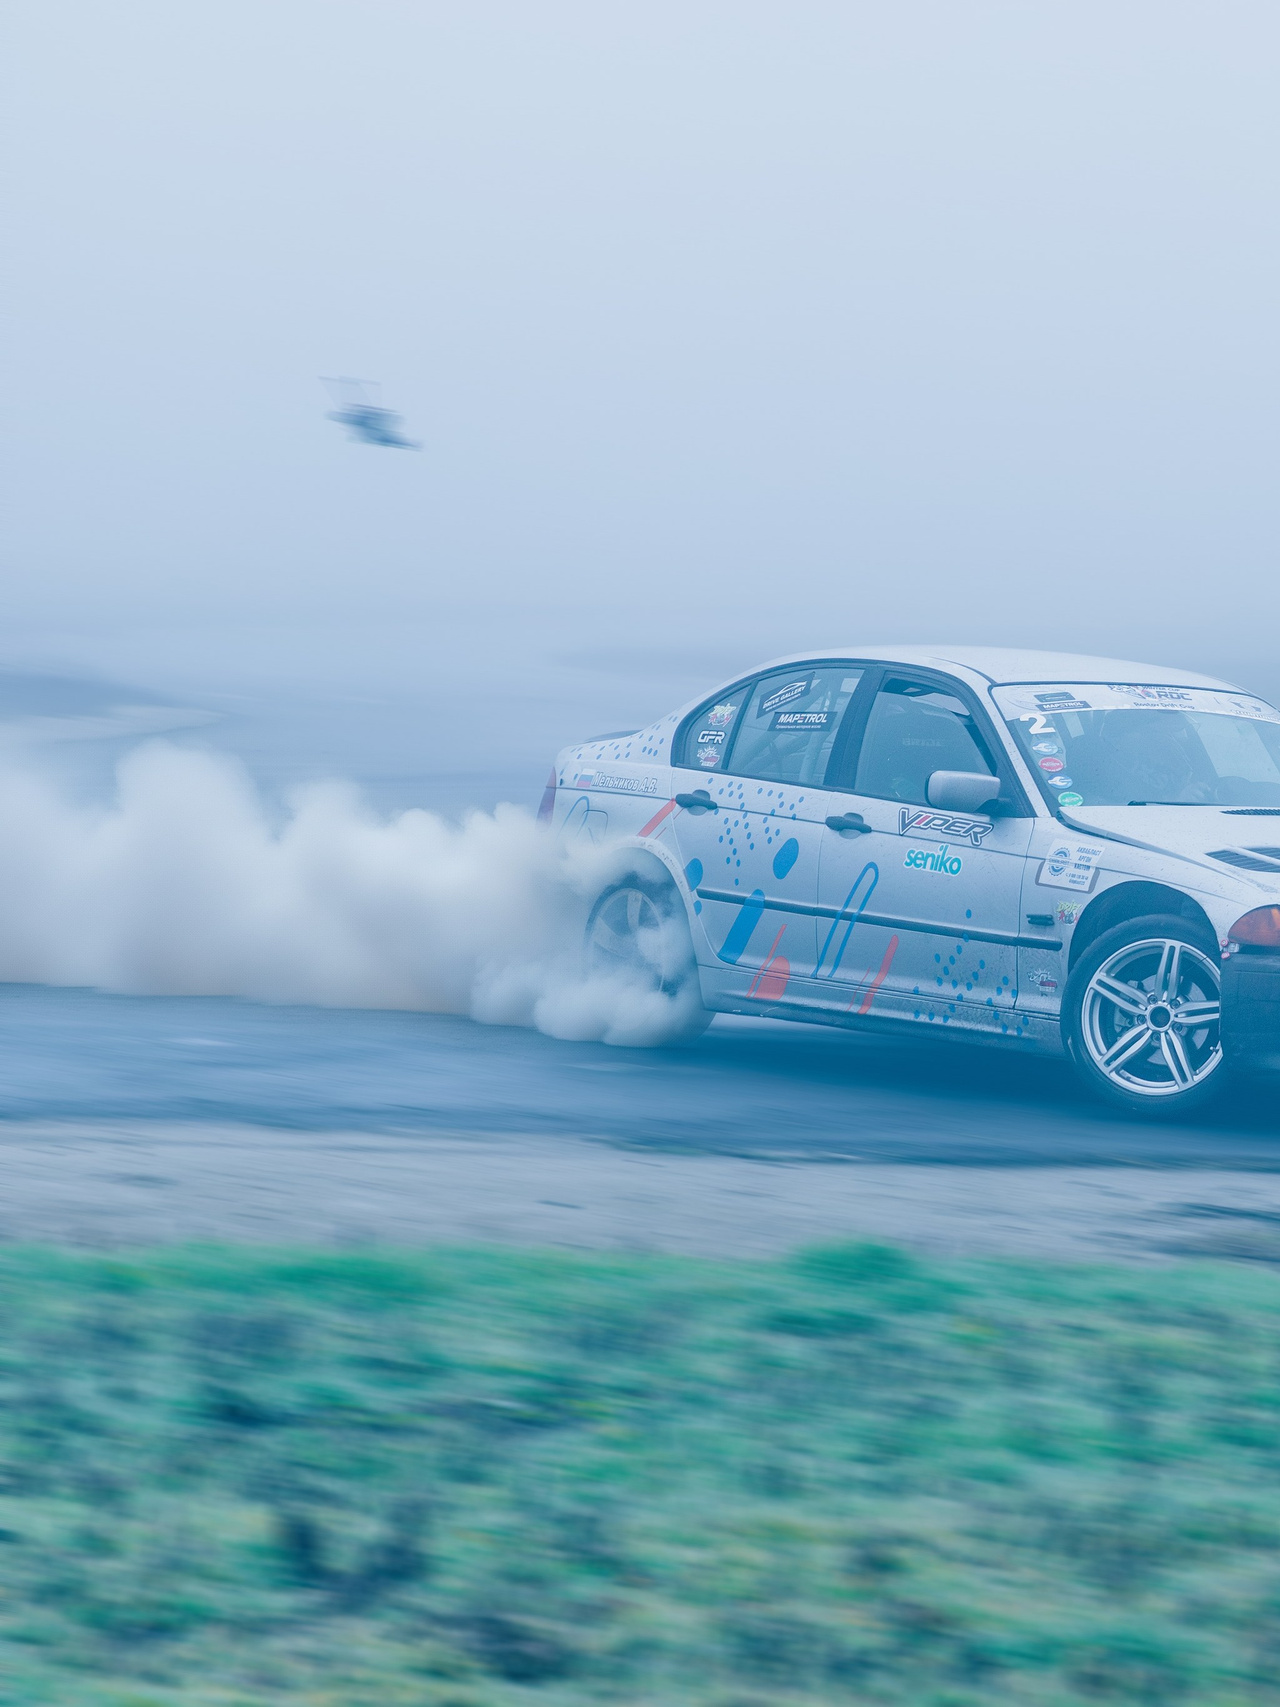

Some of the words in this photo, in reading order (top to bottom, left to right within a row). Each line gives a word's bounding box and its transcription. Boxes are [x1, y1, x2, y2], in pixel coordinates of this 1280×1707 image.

[780, 685, 807, 701] GALLERY
[1156, 690, 1193, 701] RDC
[778, 713, 828, 723] MAPETROL
[1020, 713, 1056, 735] 2
[697, 730, 726, 744] GFR
[591, 771, 640, 792] Мельников
[638, 776, 658, 794] А.В.
[899, 807, 995, 847] VIPER
[903, 844, 963, 876] seniko
